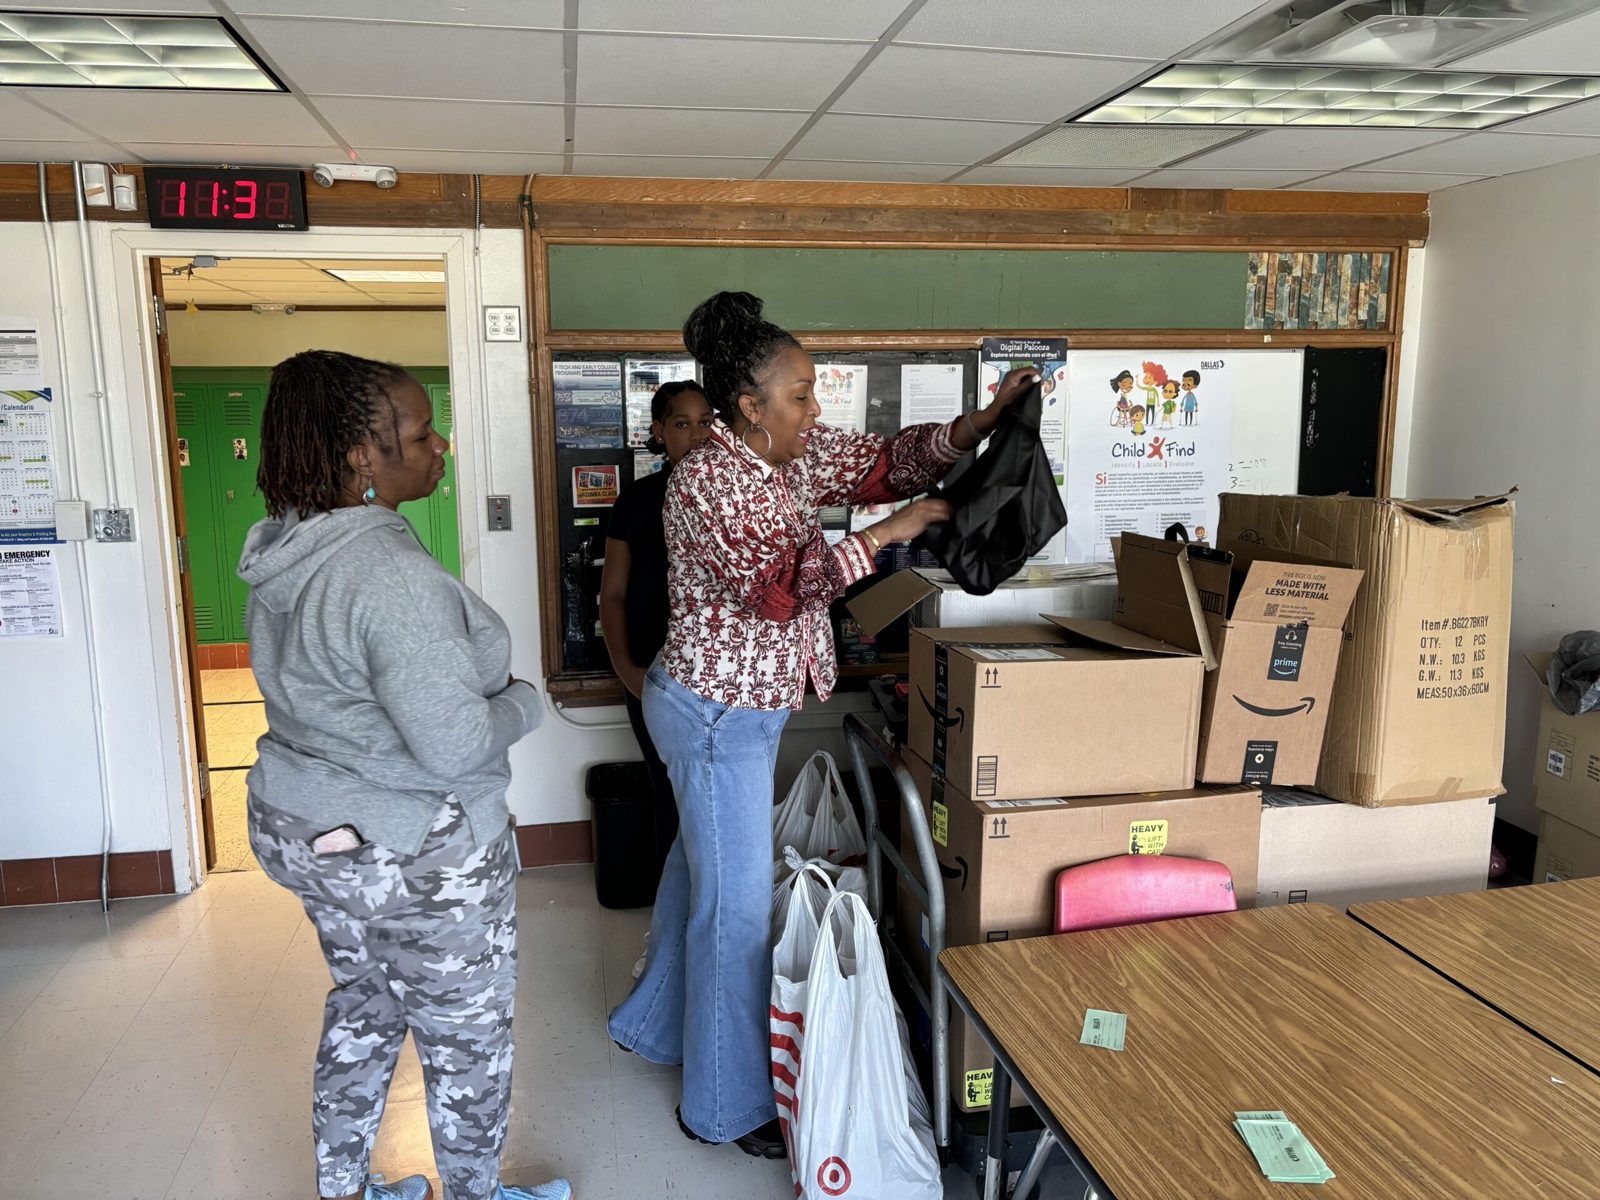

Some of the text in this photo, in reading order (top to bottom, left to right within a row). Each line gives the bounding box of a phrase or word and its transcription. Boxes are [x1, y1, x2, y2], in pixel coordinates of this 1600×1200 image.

[1000, 344, 1022, 352] Digital
[1112, 442, 1195, 458] Child Find
[1096, 472, 1106, 485] Si
[4, 550, 50, 559] EMERGENCY
[1275, 579, 1326, 591] MADE WITH
[1265, 587, 1329, 600] LESS MATERIAL
[1455, 636, 1462, 647] 12
[1473, 634, 1486, 646] PCS
[1273, 657, 1298, 667] prime
[1419, 650, 1485, 666] N.W.: 10.3 KGS
[1418, 669, 1441, 681] G.W.:
[1472, 667, 1484, 679] KGS
[1131, 824, 1163, 833] HEAVY
[967, 1071, 992, 1081] HEAV
